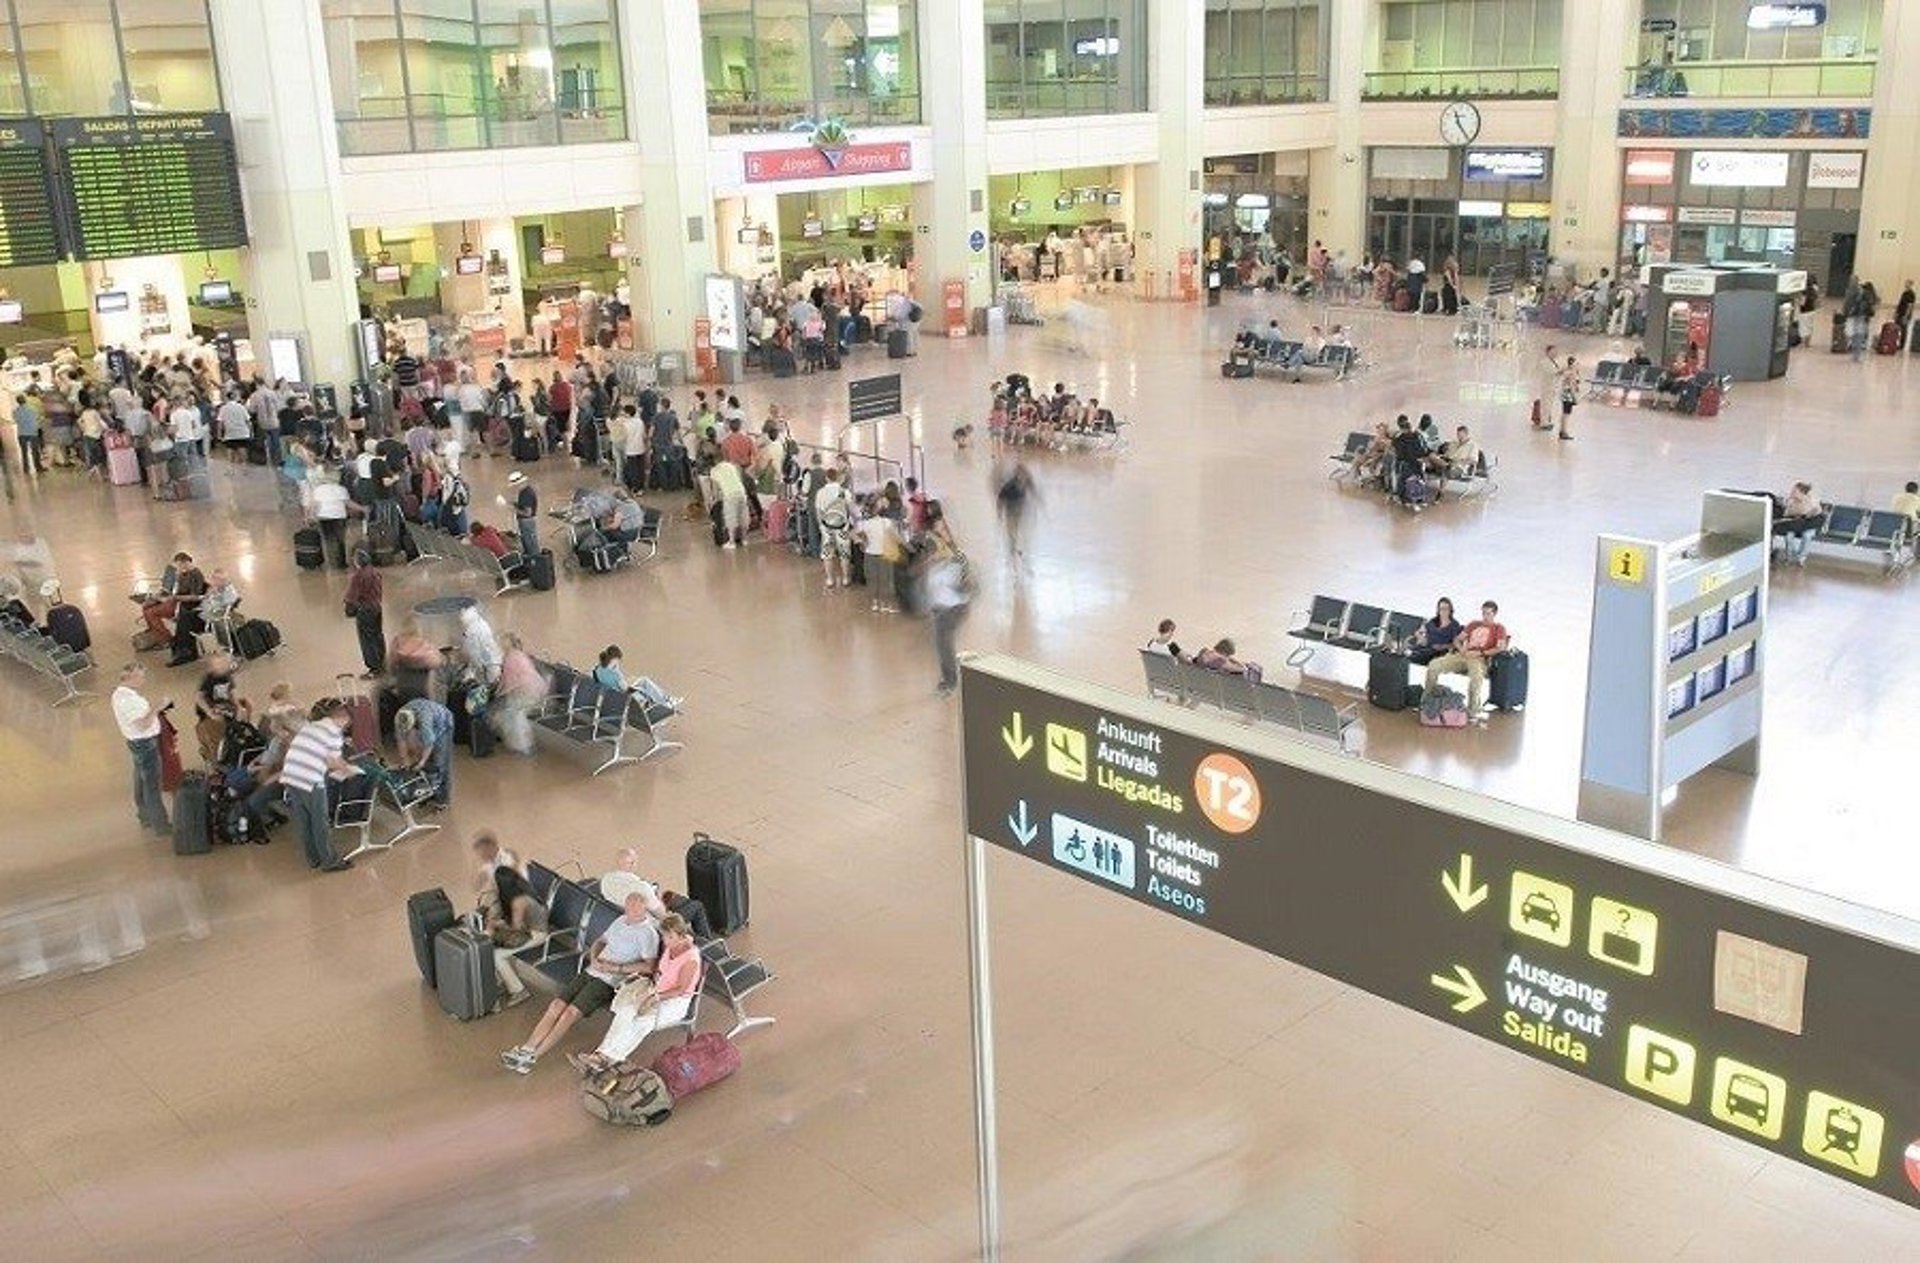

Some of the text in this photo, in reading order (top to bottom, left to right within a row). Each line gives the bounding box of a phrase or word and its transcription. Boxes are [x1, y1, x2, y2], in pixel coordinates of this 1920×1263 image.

[84, 121, 128, 132] SALIDAS
[136, 118, 204, 131] DEPARTURES
[844, 151, 892, 168] Shopping
[1620, 552, 1631, 577] i
[1097, 717, 1162, 753] Ankunft
[1098, 742, 1158, 777] Arrivals
[1098, 765, 1183, 813] Llegadas
[1203, 767, 1252, 822] T2
[1146, 825, 1219, 869] Toiletten
[1146, 849, 1202, 886] Toilets
[1147, 875, 1205, 914] Aseos
[1506, 953, 1608, 1013] Ausgang
[1505, 980, 1604, 1038] Way out
[1503, 1010, 1588, 1064] Salida
[1644, 1042, 1679, 1082] P
